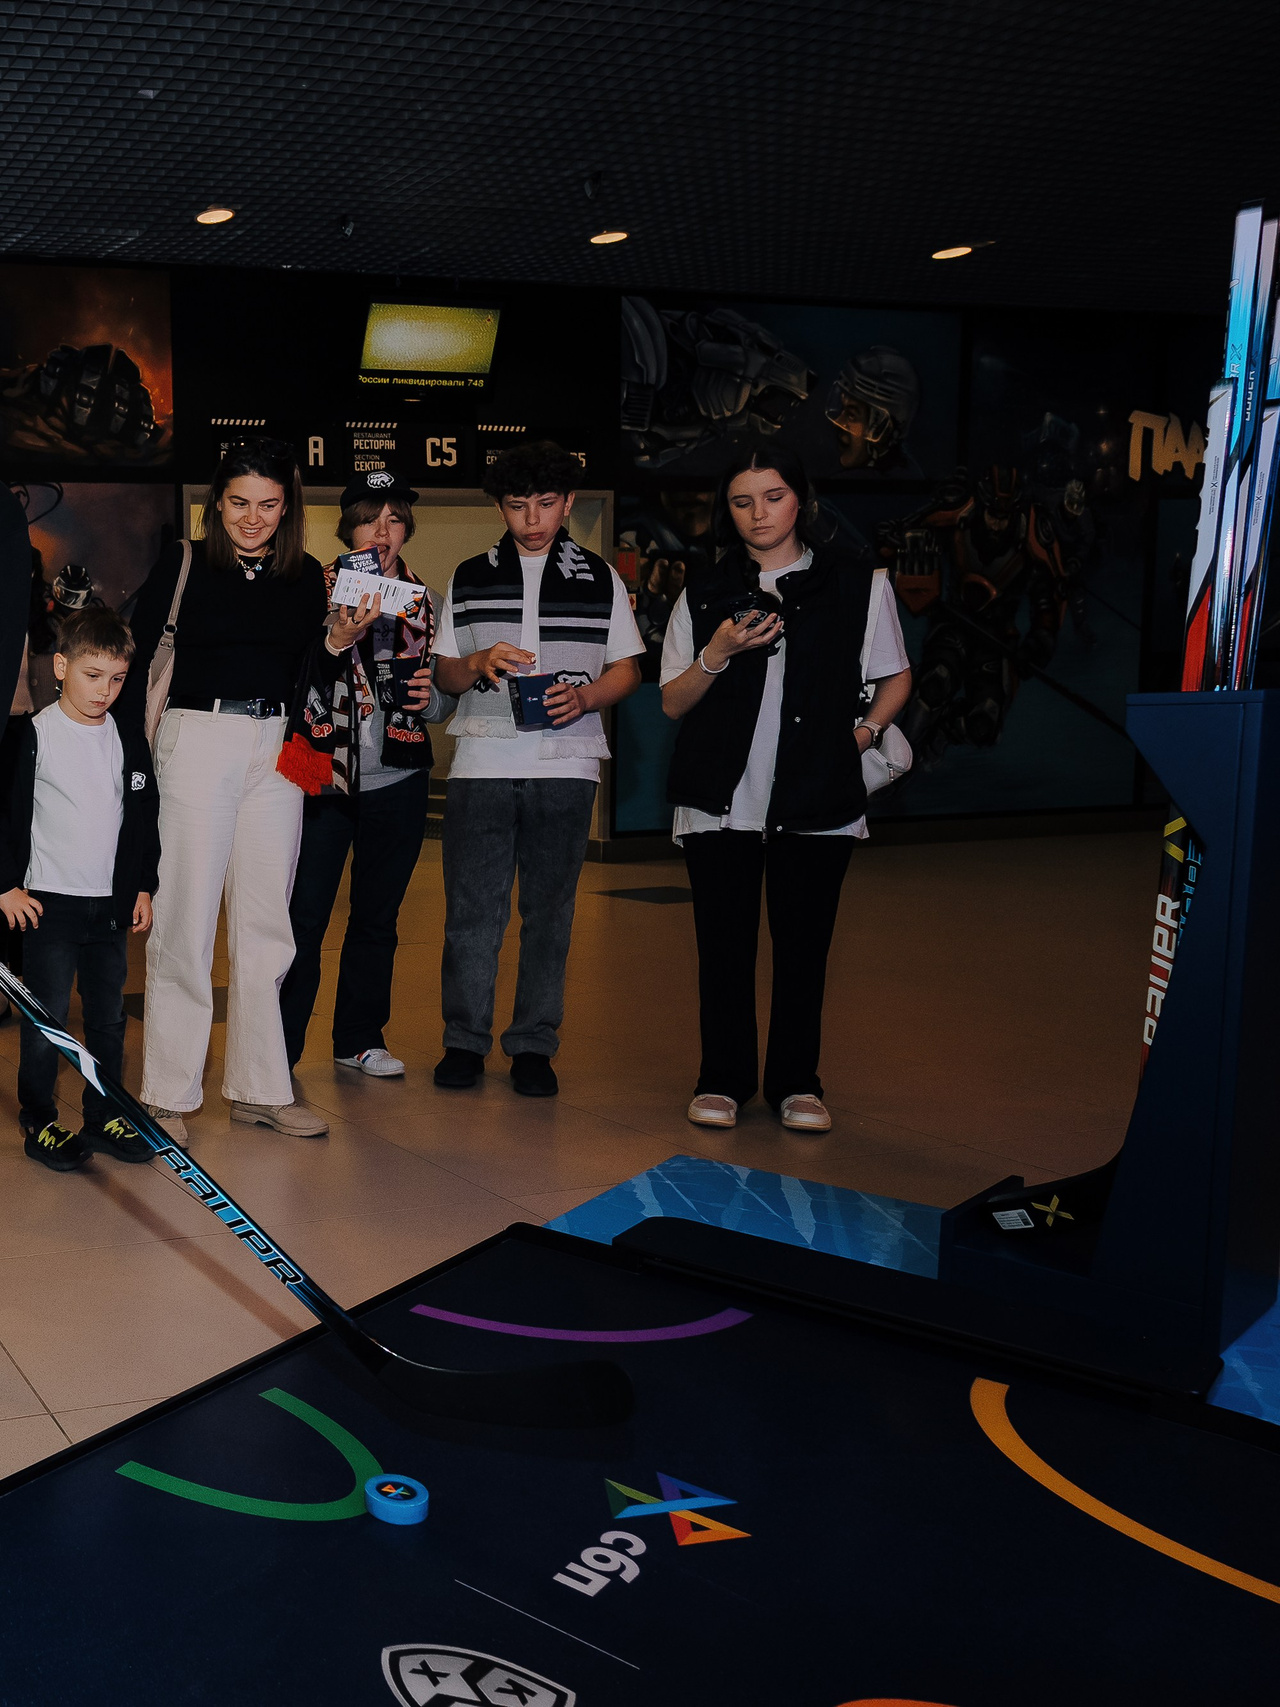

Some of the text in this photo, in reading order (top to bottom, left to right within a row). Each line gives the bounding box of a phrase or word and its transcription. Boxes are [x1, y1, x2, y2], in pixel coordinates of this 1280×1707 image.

[392, 376, 465, 388] ликвидировали
[467, 378, 484, 388] 748
[353, 438, 396, 451] РЕСТОРАН
[354, 453, 381, 461] SECTION
[552, 1529, 648, 1598] сбп
